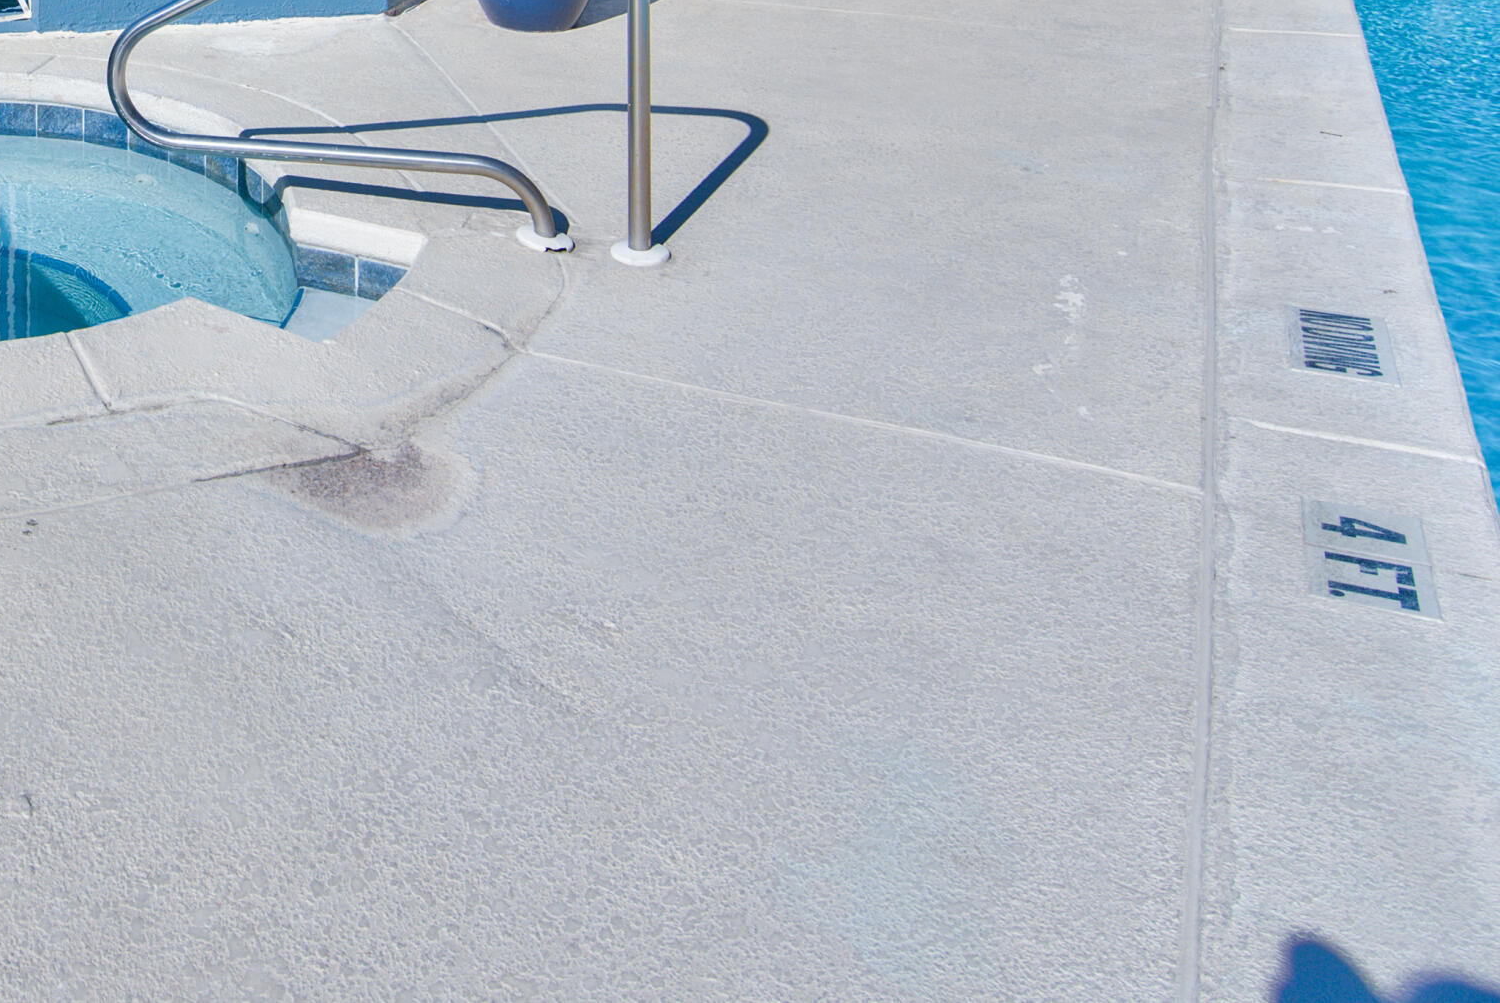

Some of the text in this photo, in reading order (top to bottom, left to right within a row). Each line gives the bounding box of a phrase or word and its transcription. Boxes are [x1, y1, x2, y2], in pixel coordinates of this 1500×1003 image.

[1299, 309, 1383, 376] NO DIVING
[1321, 516, 1407, 545] 4
